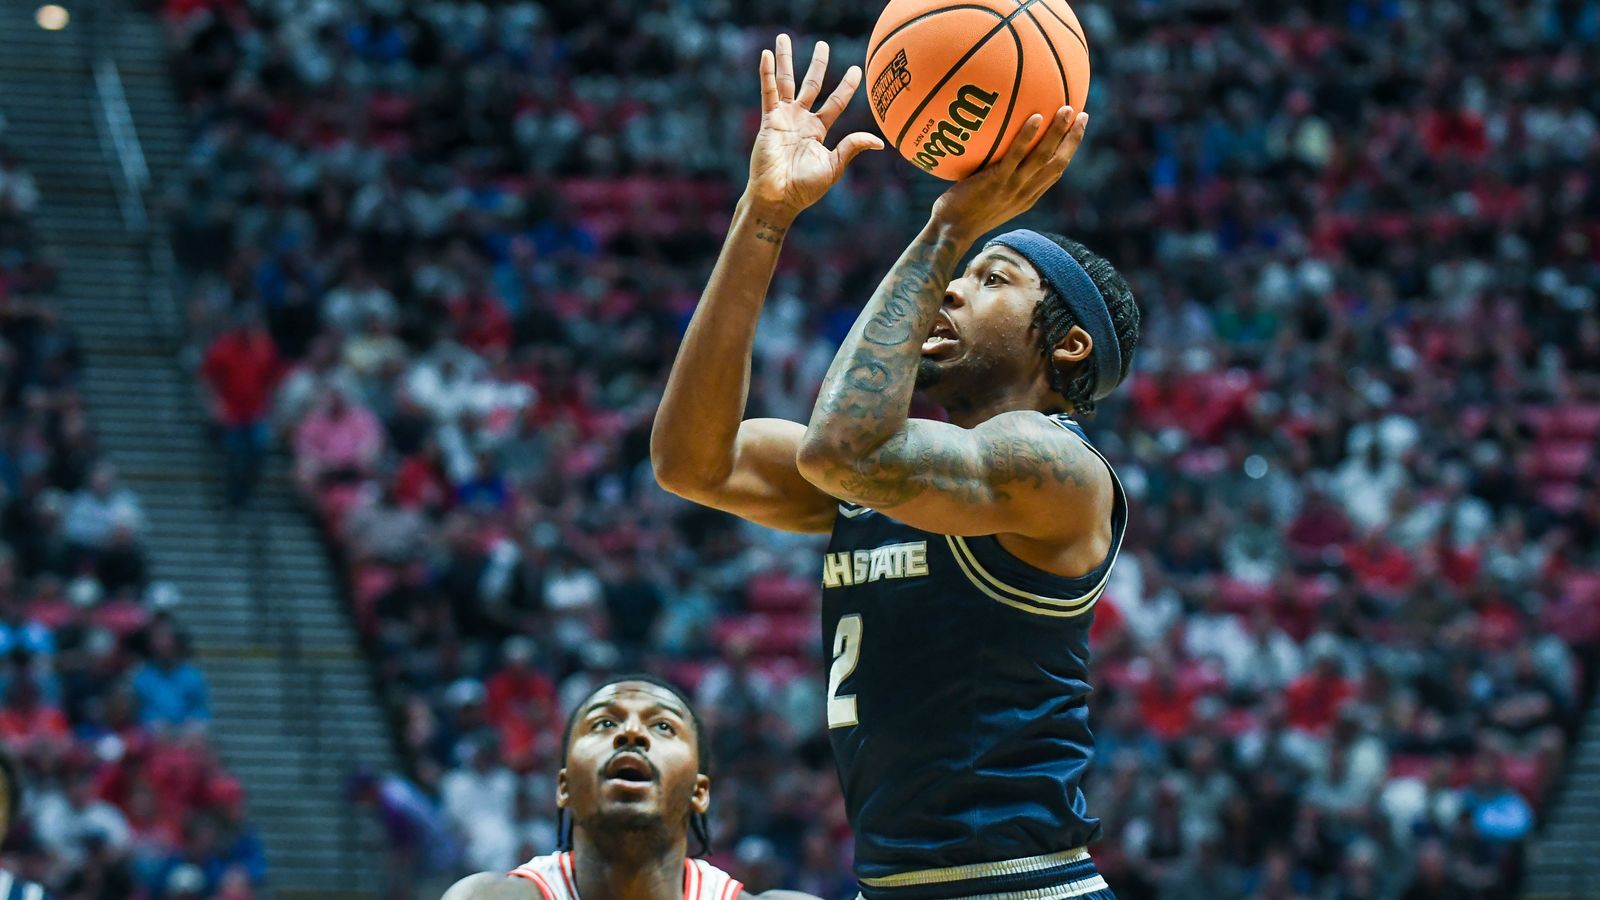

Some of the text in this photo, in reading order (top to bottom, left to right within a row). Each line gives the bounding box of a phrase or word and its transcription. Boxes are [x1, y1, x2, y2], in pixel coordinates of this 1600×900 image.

[914, 118, 935, 147] EVO NXT
[854, 540, 930, 584] STATE
[827, 613, 863, 729] 2
